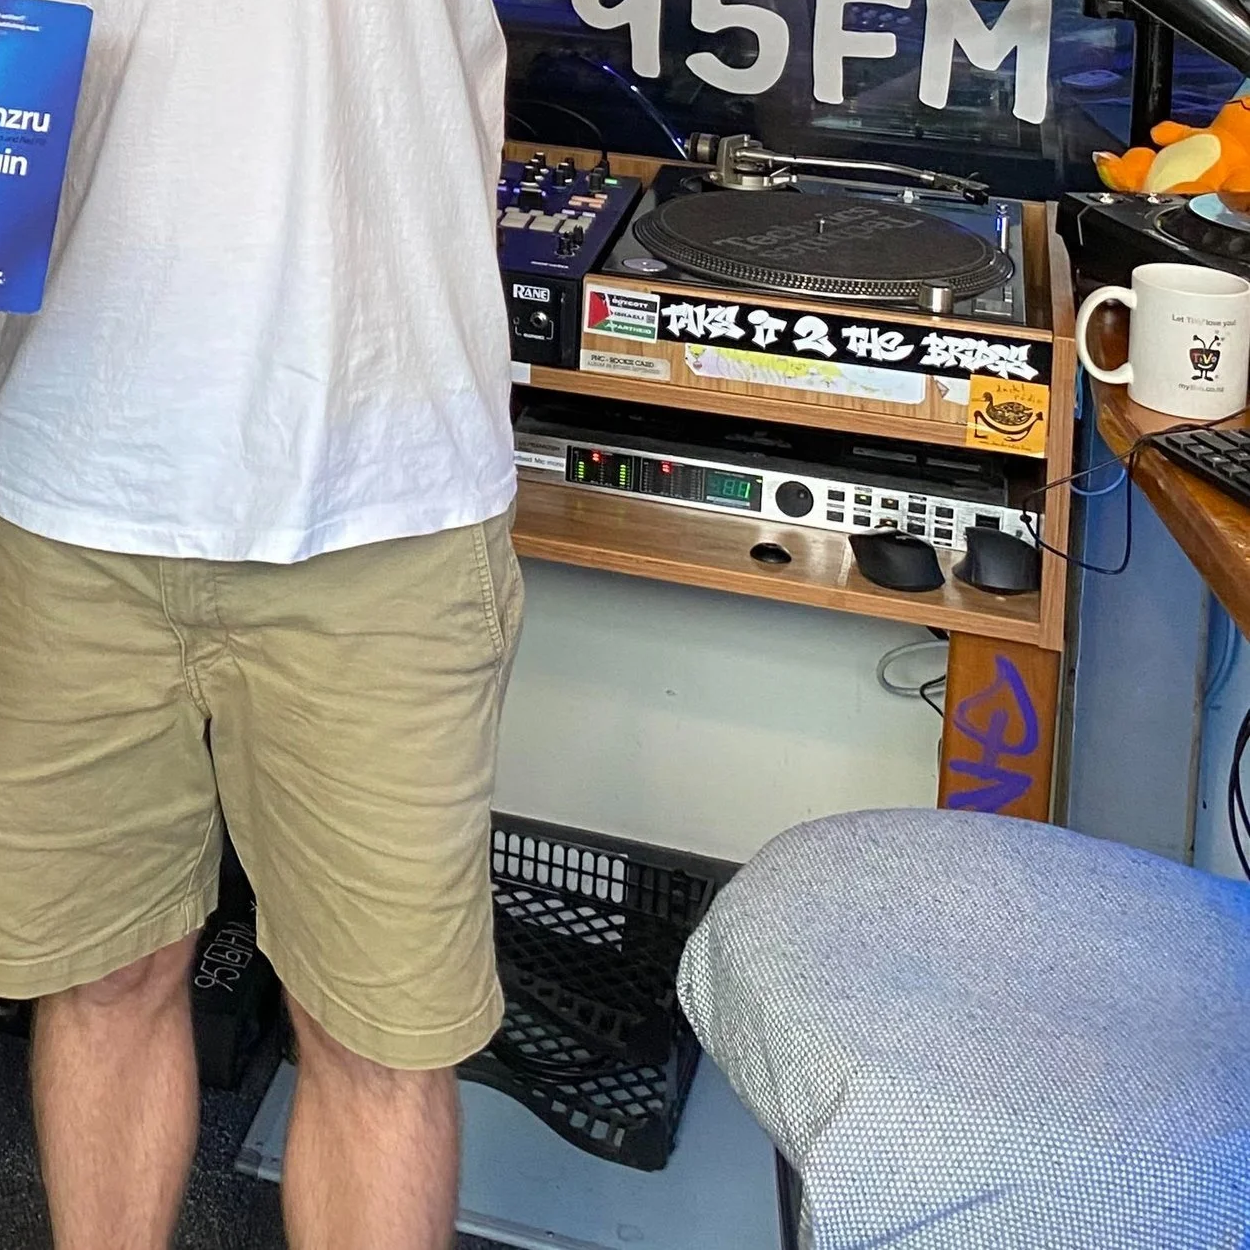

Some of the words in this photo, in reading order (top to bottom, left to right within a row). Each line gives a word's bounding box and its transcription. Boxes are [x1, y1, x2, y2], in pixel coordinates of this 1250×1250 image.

[713, 205, 880, 250] Technics
[513, 284, 551, 302] RANE
[793, 315, 837, 358] 2
